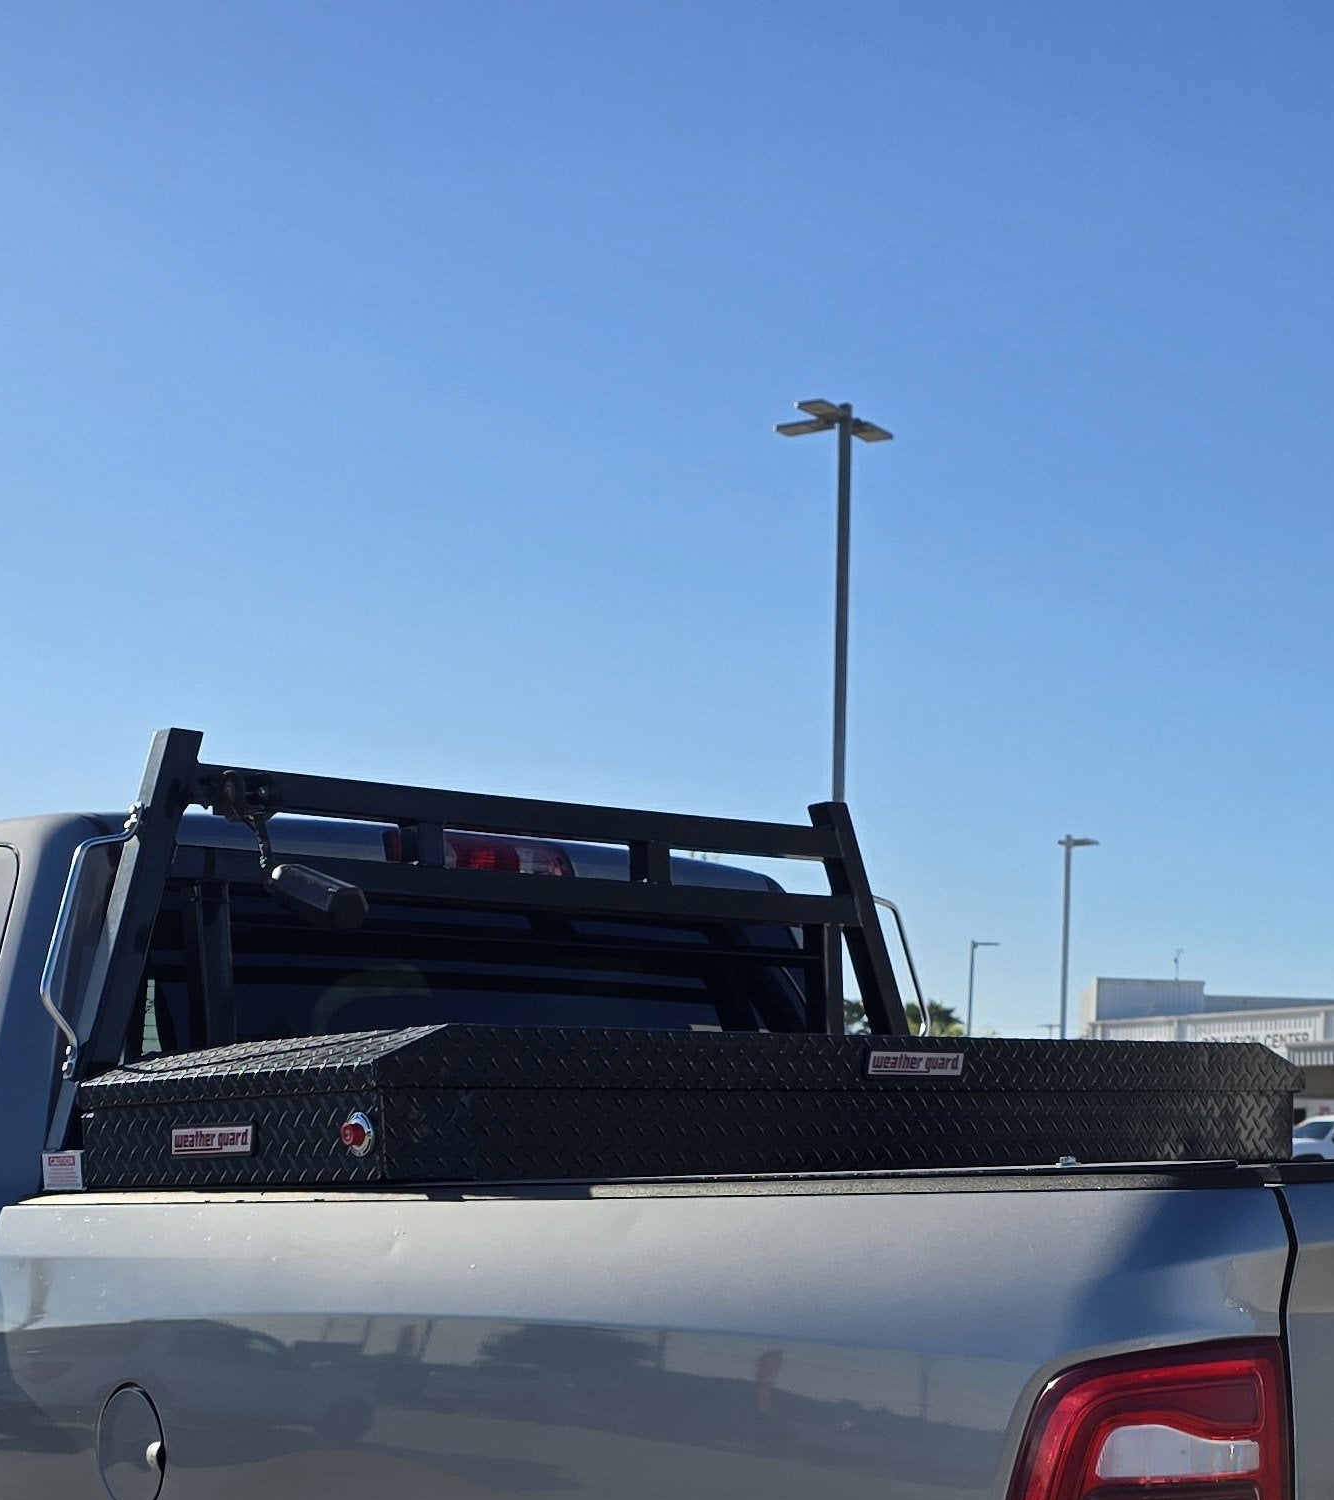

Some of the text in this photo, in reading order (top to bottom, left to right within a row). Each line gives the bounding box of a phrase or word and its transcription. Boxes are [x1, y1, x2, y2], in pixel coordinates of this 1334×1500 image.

[872, 1053, 960, 1073] weather guard
[174, 1128, 249, 1151] weather guard
